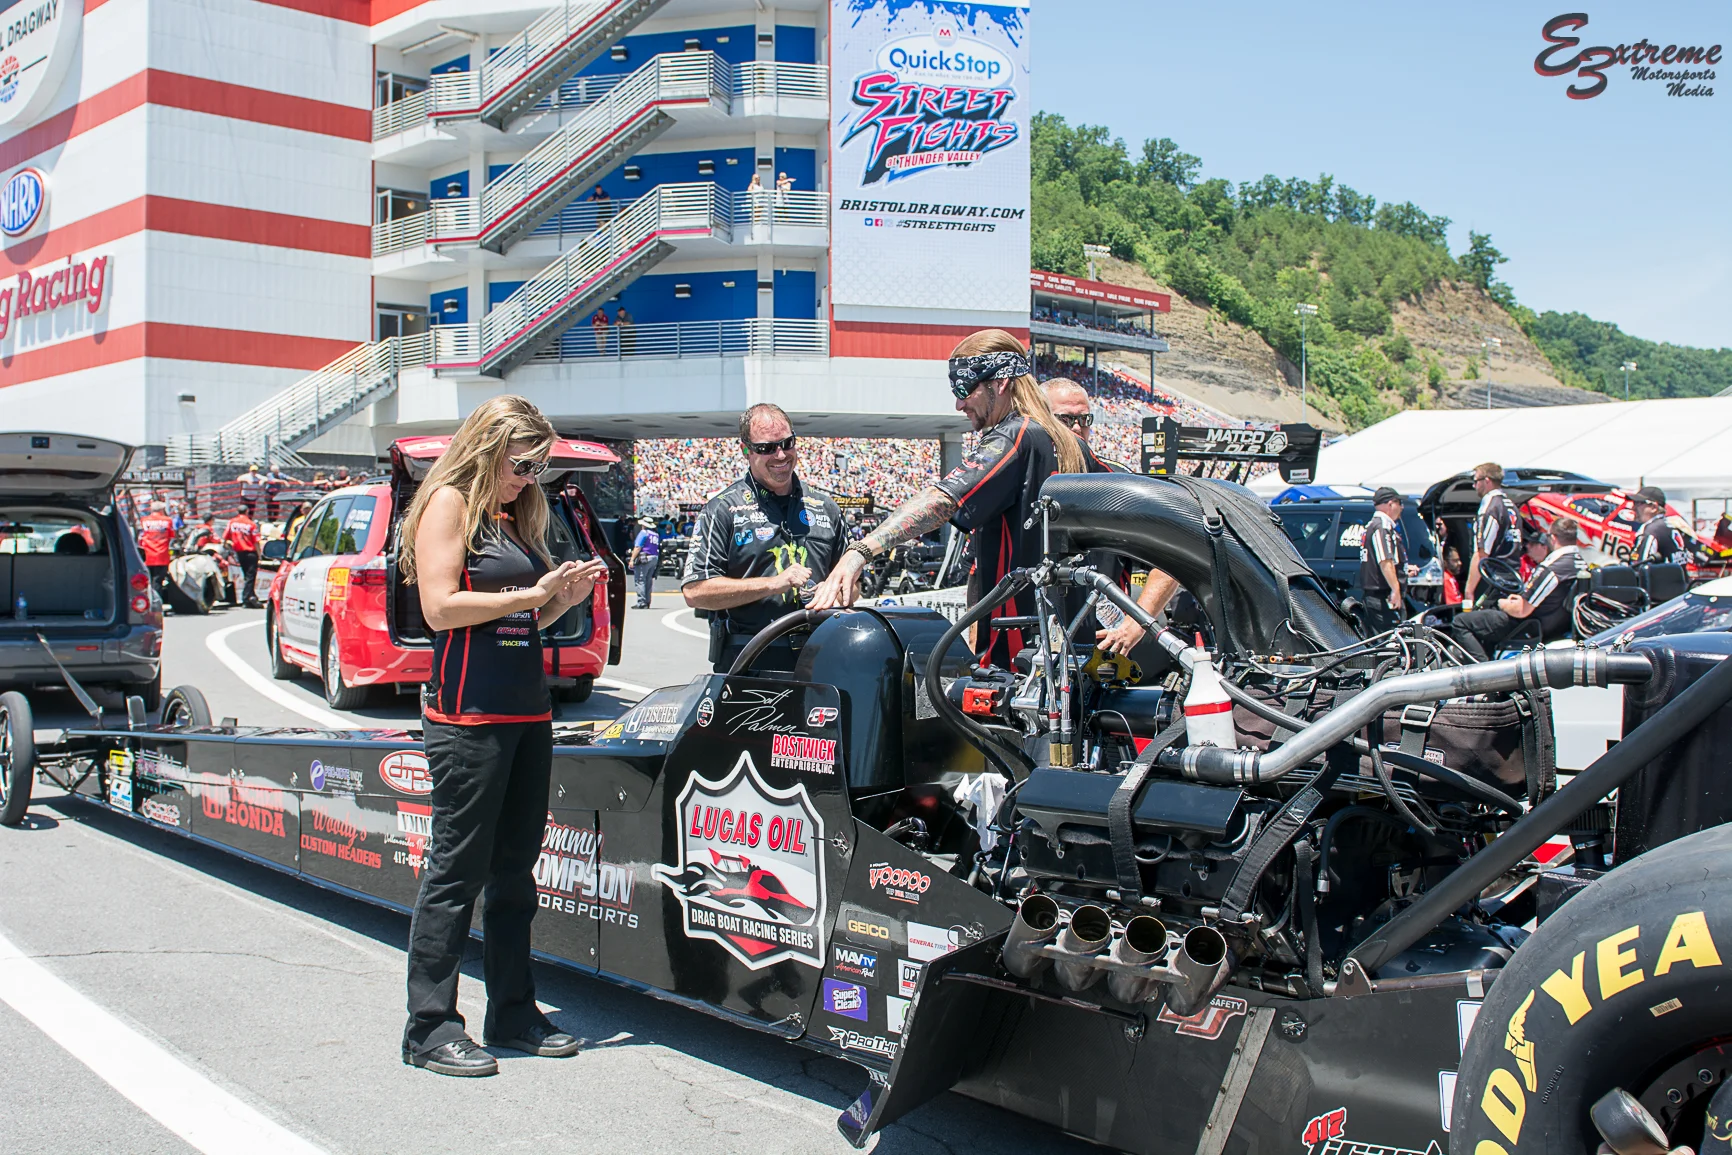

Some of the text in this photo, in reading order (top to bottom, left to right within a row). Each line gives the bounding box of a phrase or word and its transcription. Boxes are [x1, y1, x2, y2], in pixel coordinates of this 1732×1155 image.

[8, 2, 59, 48] DRAGWAY
[853, 72, 1015, 128] STREET
[868, 113, 1018, 171] FIGHTS
[899, 152, 945, 169] THUNDER
[947, 152, 982, 163] VALLEY
[0, 175, 37, 230] NHRA
[839, 199, 1025, 219] BRISTOLDRAGWAY.COM
[896, 219, 996, 233] #STREETFIGHTS
[14, 254, 108, 320] Racing
[1206, 428, 1266, 444] MATCO
[643, 707, 679, 723] FISCHER
[772, 734, 836, 763] BOSTWICK
[225, 801, 286, 838] HONDA
[312, 806, 367, 847] Woody's
[689, 804, 807, 854] LUCAS OIL
[300, 833, 382, 869] CUSTOM HEADERS
[869, 866, 931, 893] VOODOO
[691, 907, 813, 950] DRAG BOAT RACING SERIES
[848, 919, 889, 940] GEICO
[909, 937, 947, 951] GENERAL TIRE
[835, 962, 861, 975] American
[832, 988, 857, 1002] Super
[834, 998, 858, 1010] Clean
[1209, 998, 1243, 1011] SAFETY
[1302, 1106, 1347, 1146] 417
